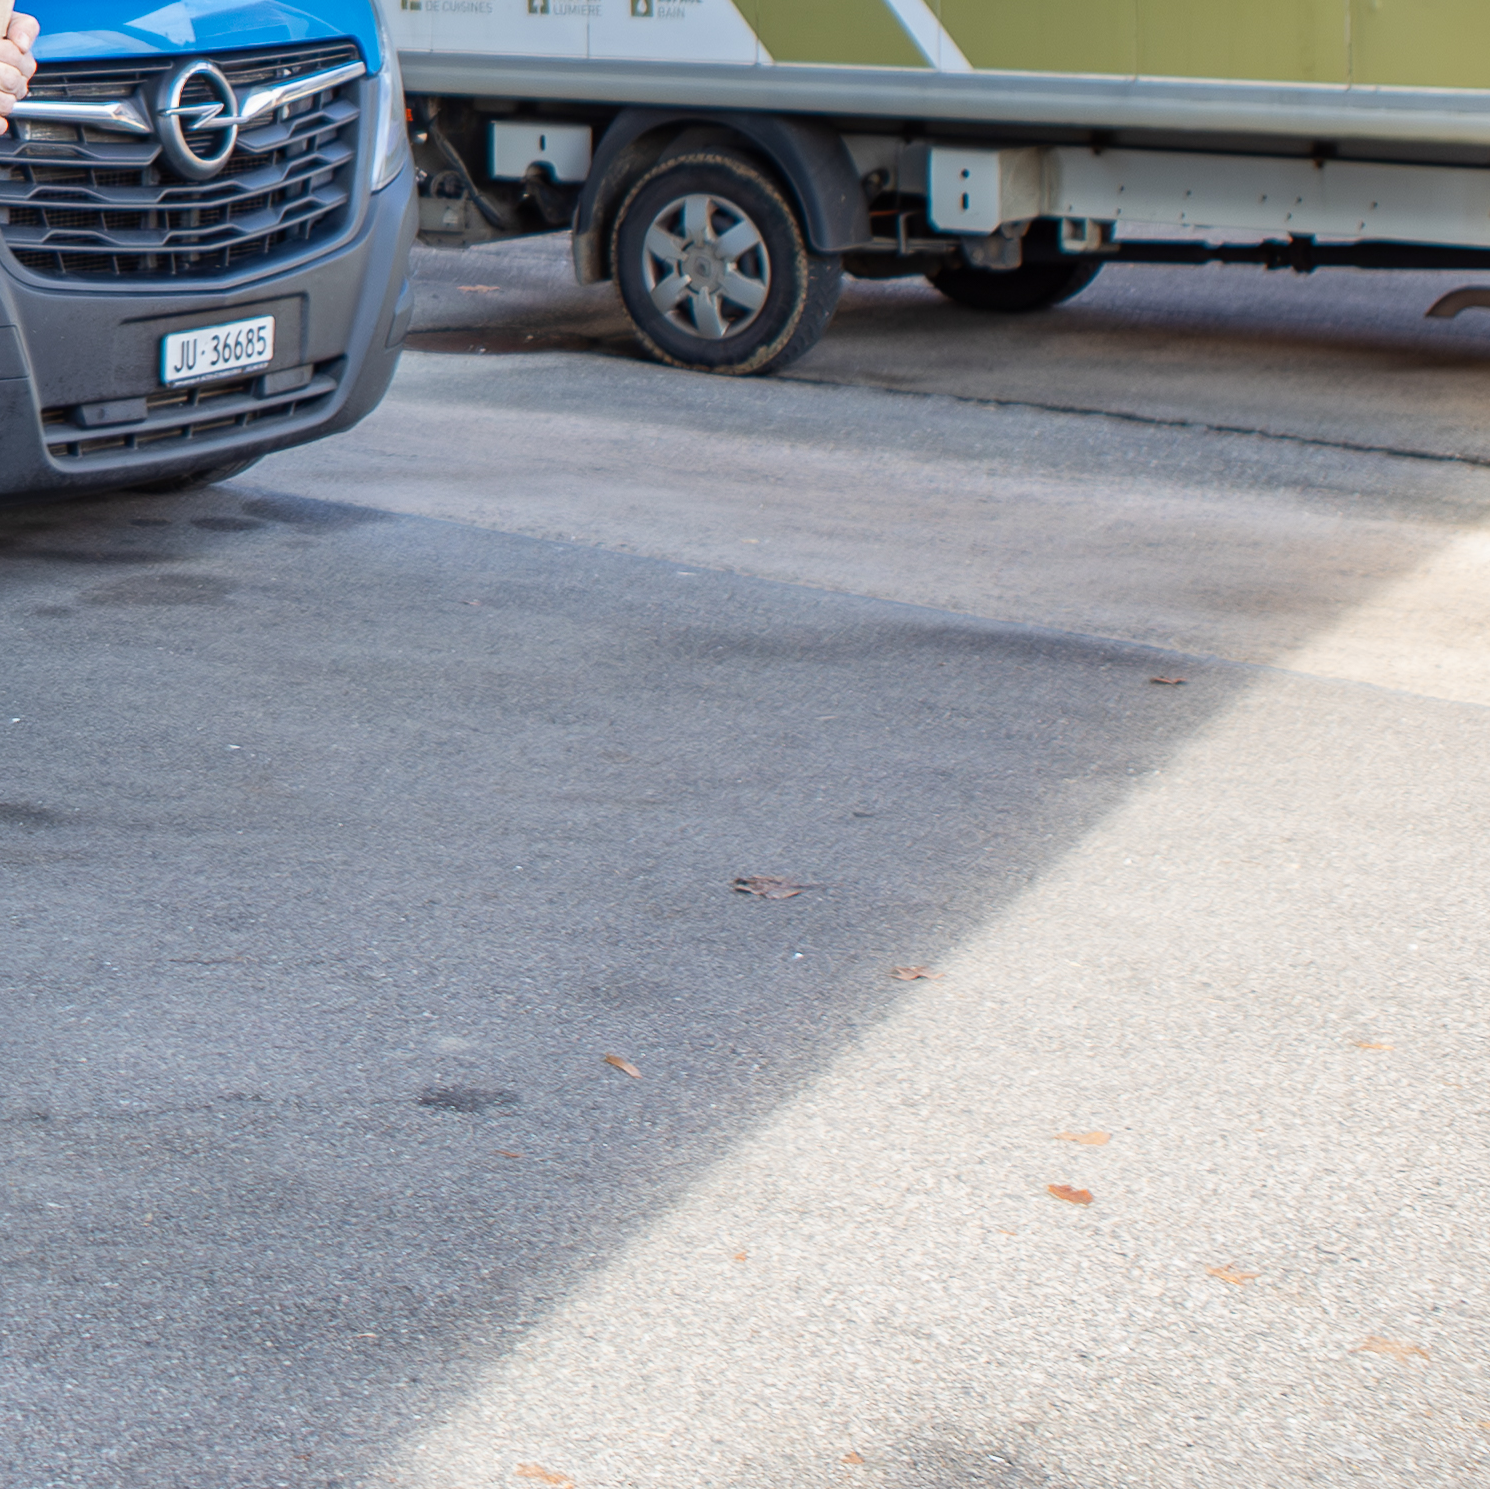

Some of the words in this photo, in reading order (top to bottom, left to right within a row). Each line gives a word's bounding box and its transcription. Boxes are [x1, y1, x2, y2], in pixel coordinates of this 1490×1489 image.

[425, 0, 440, 11] DE
[442, 1, 494, 14] CUISINES
[657, 7, 686, 19] BAIN
[173, 339, 198, 373] JU
[210, 325, 268, 366] 36685
